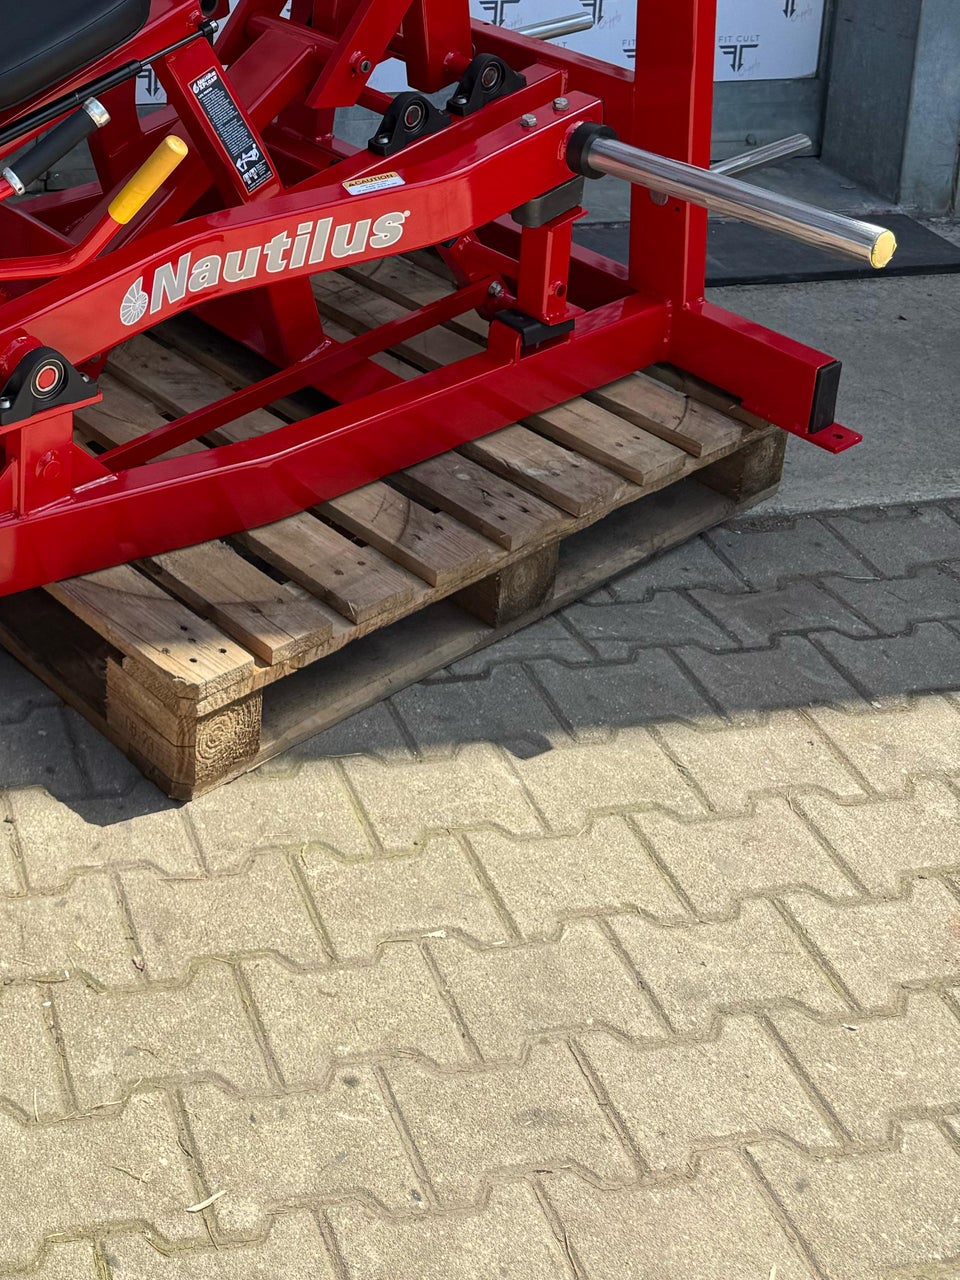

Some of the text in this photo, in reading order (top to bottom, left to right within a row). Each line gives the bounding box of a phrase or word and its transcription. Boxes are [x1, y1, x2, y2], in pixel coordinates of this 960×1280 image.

[718, 34, 761, 43] FIT CULT
[354, 173, 394, 186] CAUTION
[149, 210, 407, 315] Nautilus
